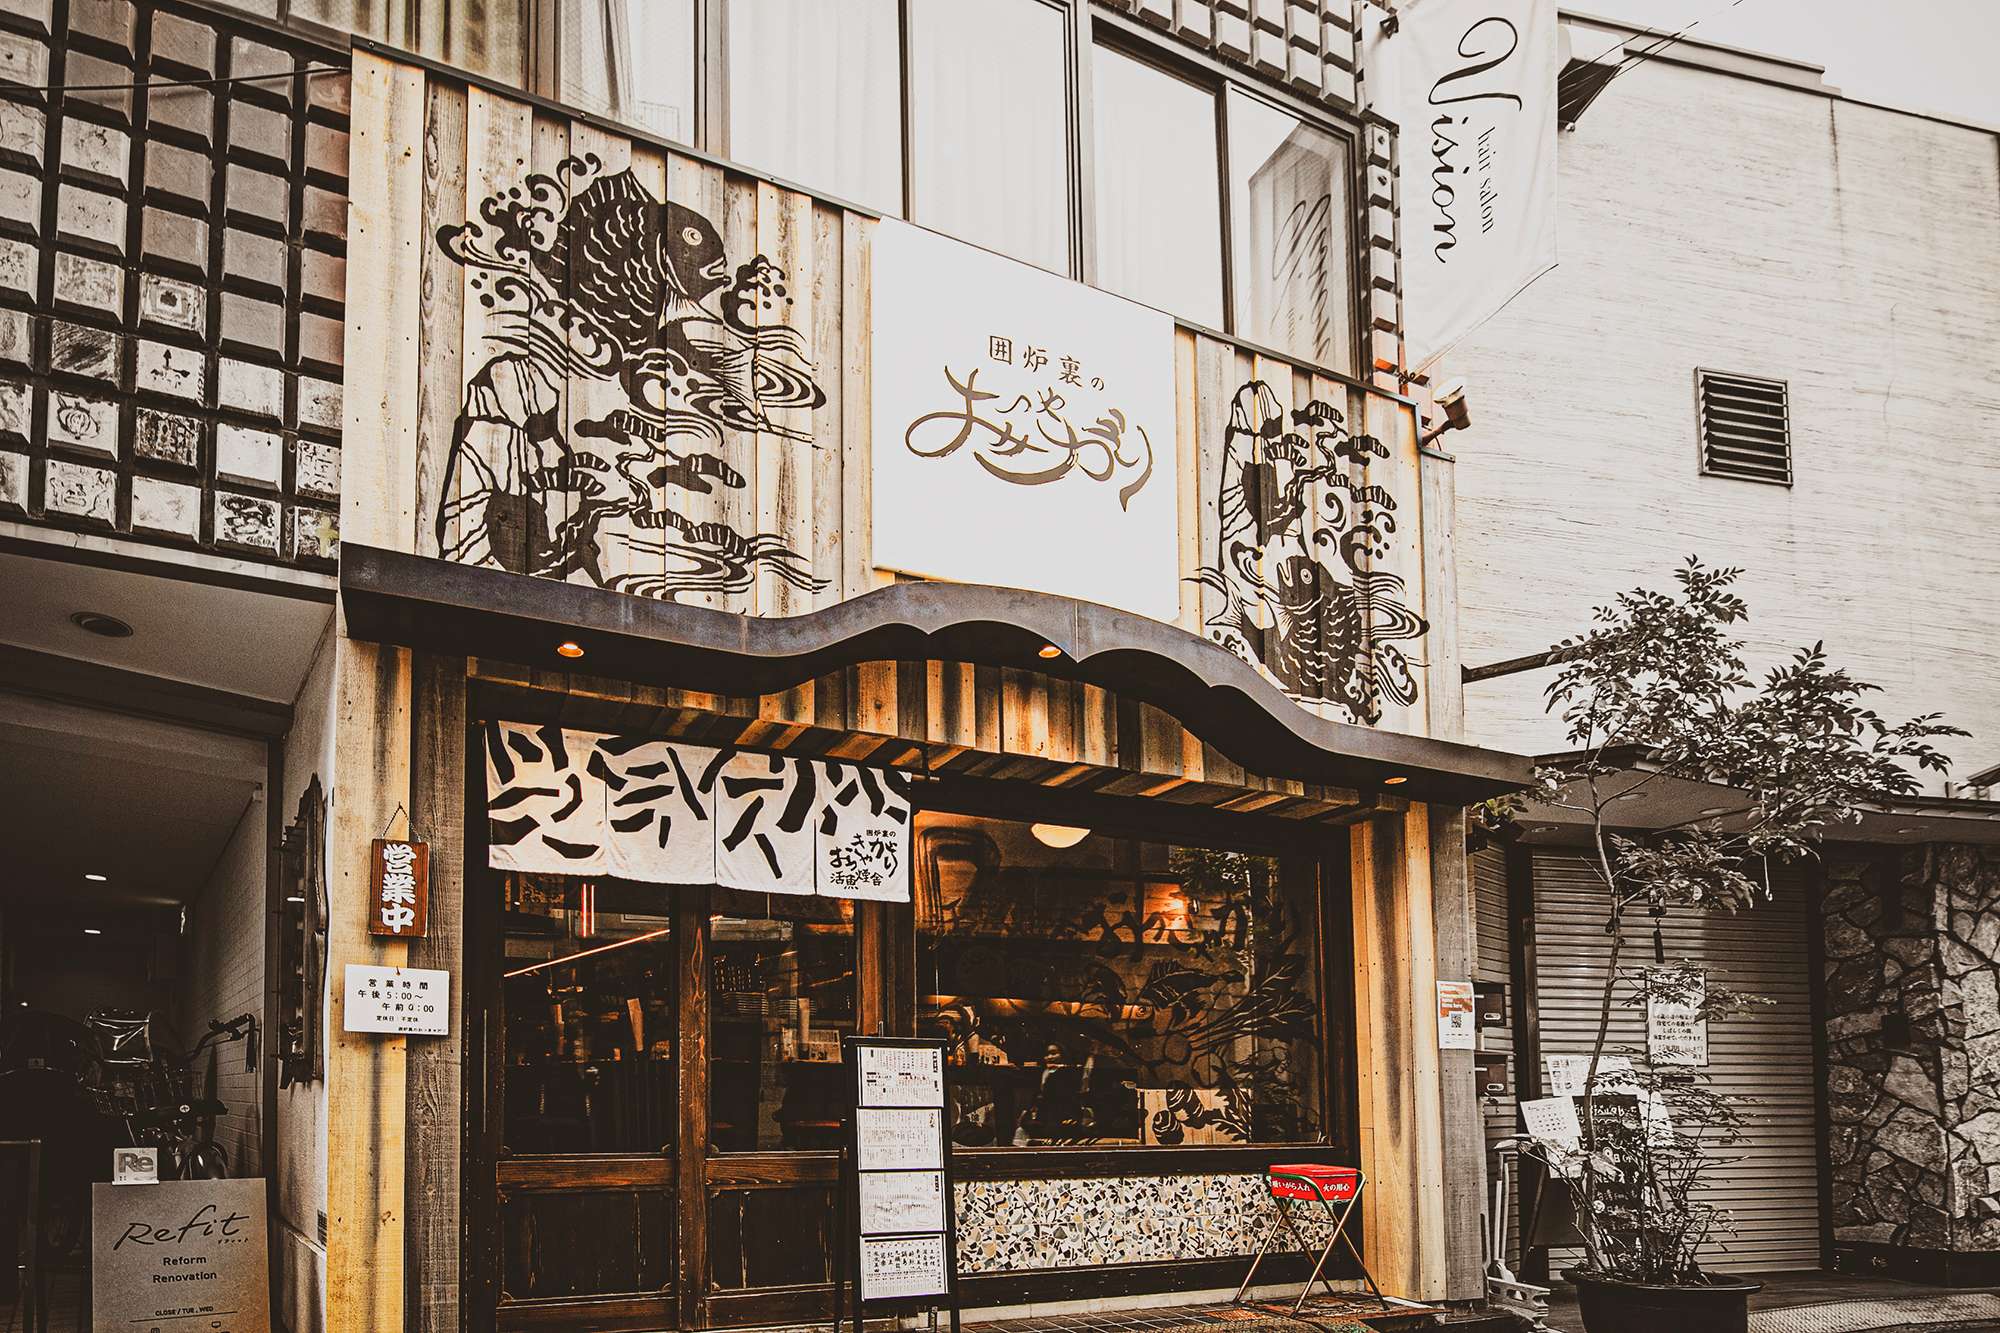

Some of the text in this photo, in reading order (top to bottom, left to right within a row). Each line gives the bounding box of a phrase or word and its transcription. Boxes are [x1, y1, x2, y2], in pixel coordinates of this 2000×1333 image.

[1428, 16, 1523, 263] Vision
[1477, 126, 1499, 234] hair salon
[989, 335, 1105, 391] 囲炉裏の
[381, 843, 417, 934] 営業中
[368, 978, 428, 990] 営業時間
[113, 1204, 250, 1250] Refit
[153, 1271, 217, 1283] Renovation
[163, 1255, 207, 1266] Reform
